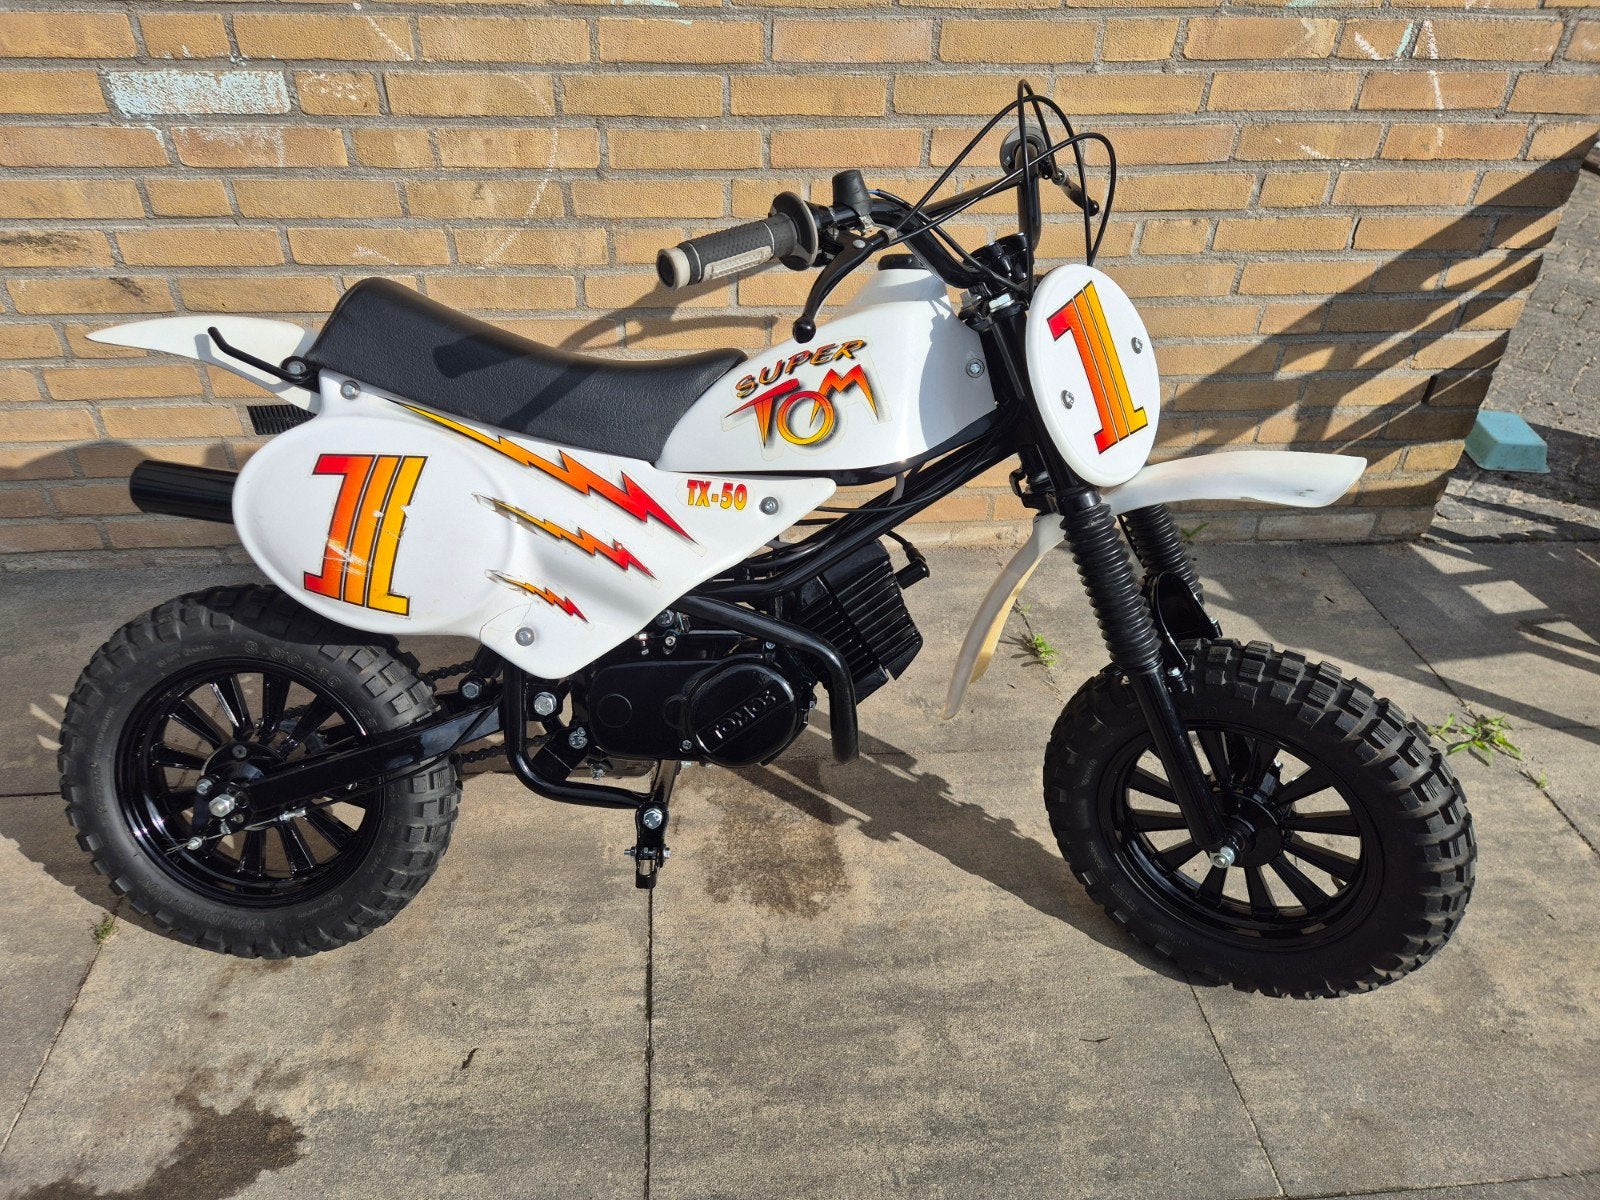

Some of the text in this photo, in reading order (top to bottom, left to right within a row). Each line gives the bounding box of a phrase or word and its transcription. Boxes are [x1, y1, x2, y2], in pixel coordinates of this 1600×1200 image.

[735, 339, 866, 399] SUPER
[724, 364, 880, 449] TOM
[687, 479, 748, 511] TX-50
